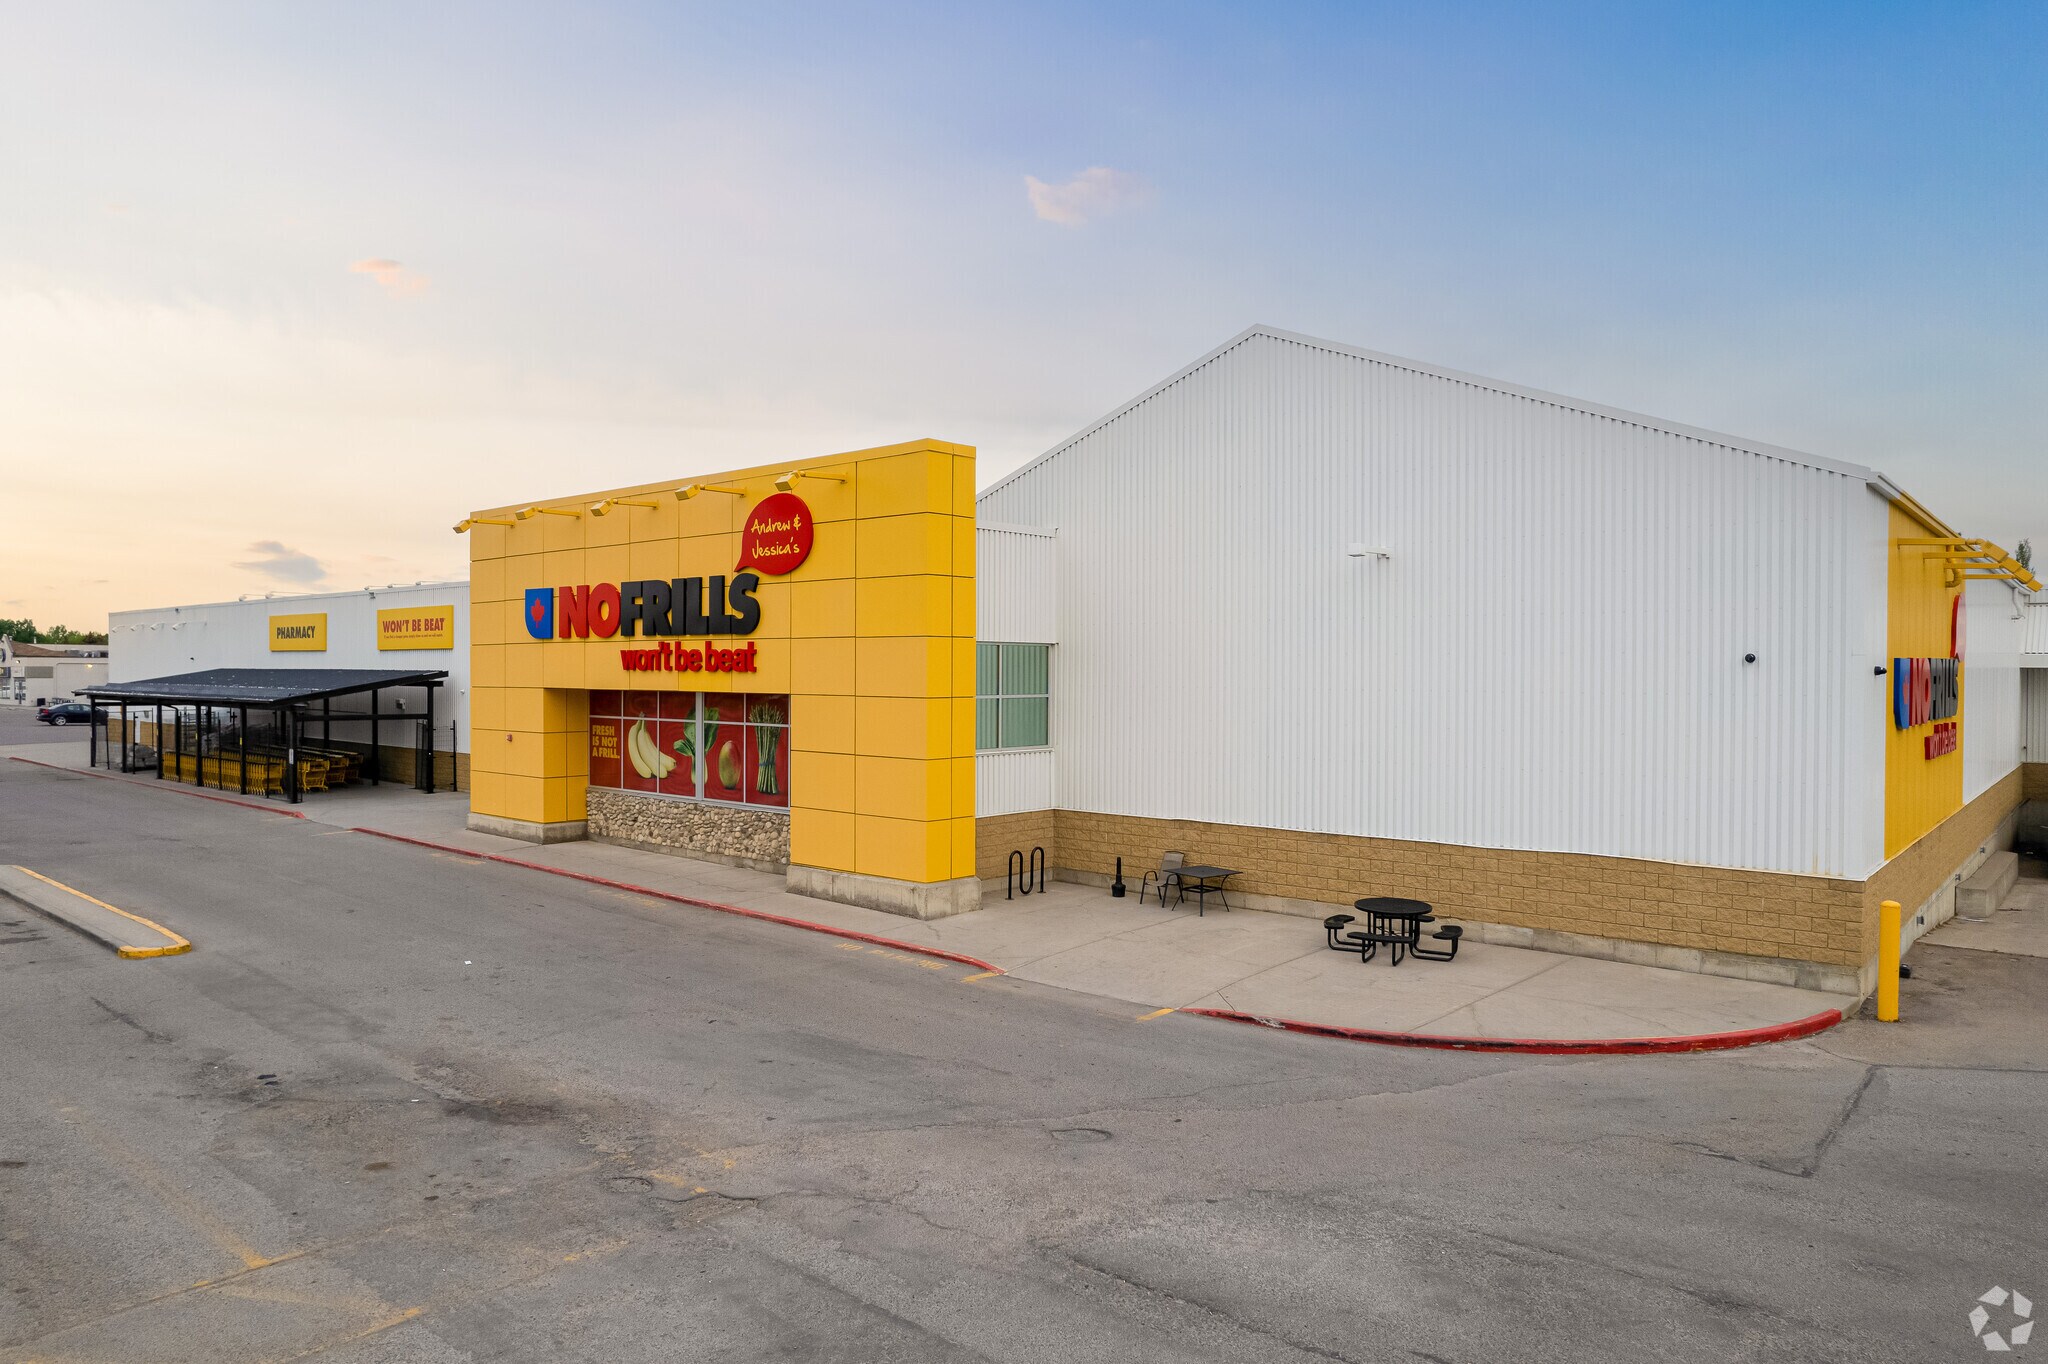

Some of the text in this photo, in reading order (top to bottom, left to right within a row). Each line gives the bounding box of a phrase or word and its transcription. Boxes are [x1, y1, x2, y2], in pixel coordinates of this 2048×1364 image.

[751, 513, 801, 535] Andrew &
[752, 536, 800, 559] Jessica's
[382, 617, 445, 633] WON'T BE BEAT
[276, 626, 315, 639] PHARMACY
[620, 640, 757, 673] won't be beat
[592, 725, 615, 736] FRESH
[592, 736, 617, 747] IS NOT
[592, 747, 620, 759] A FRILL.
